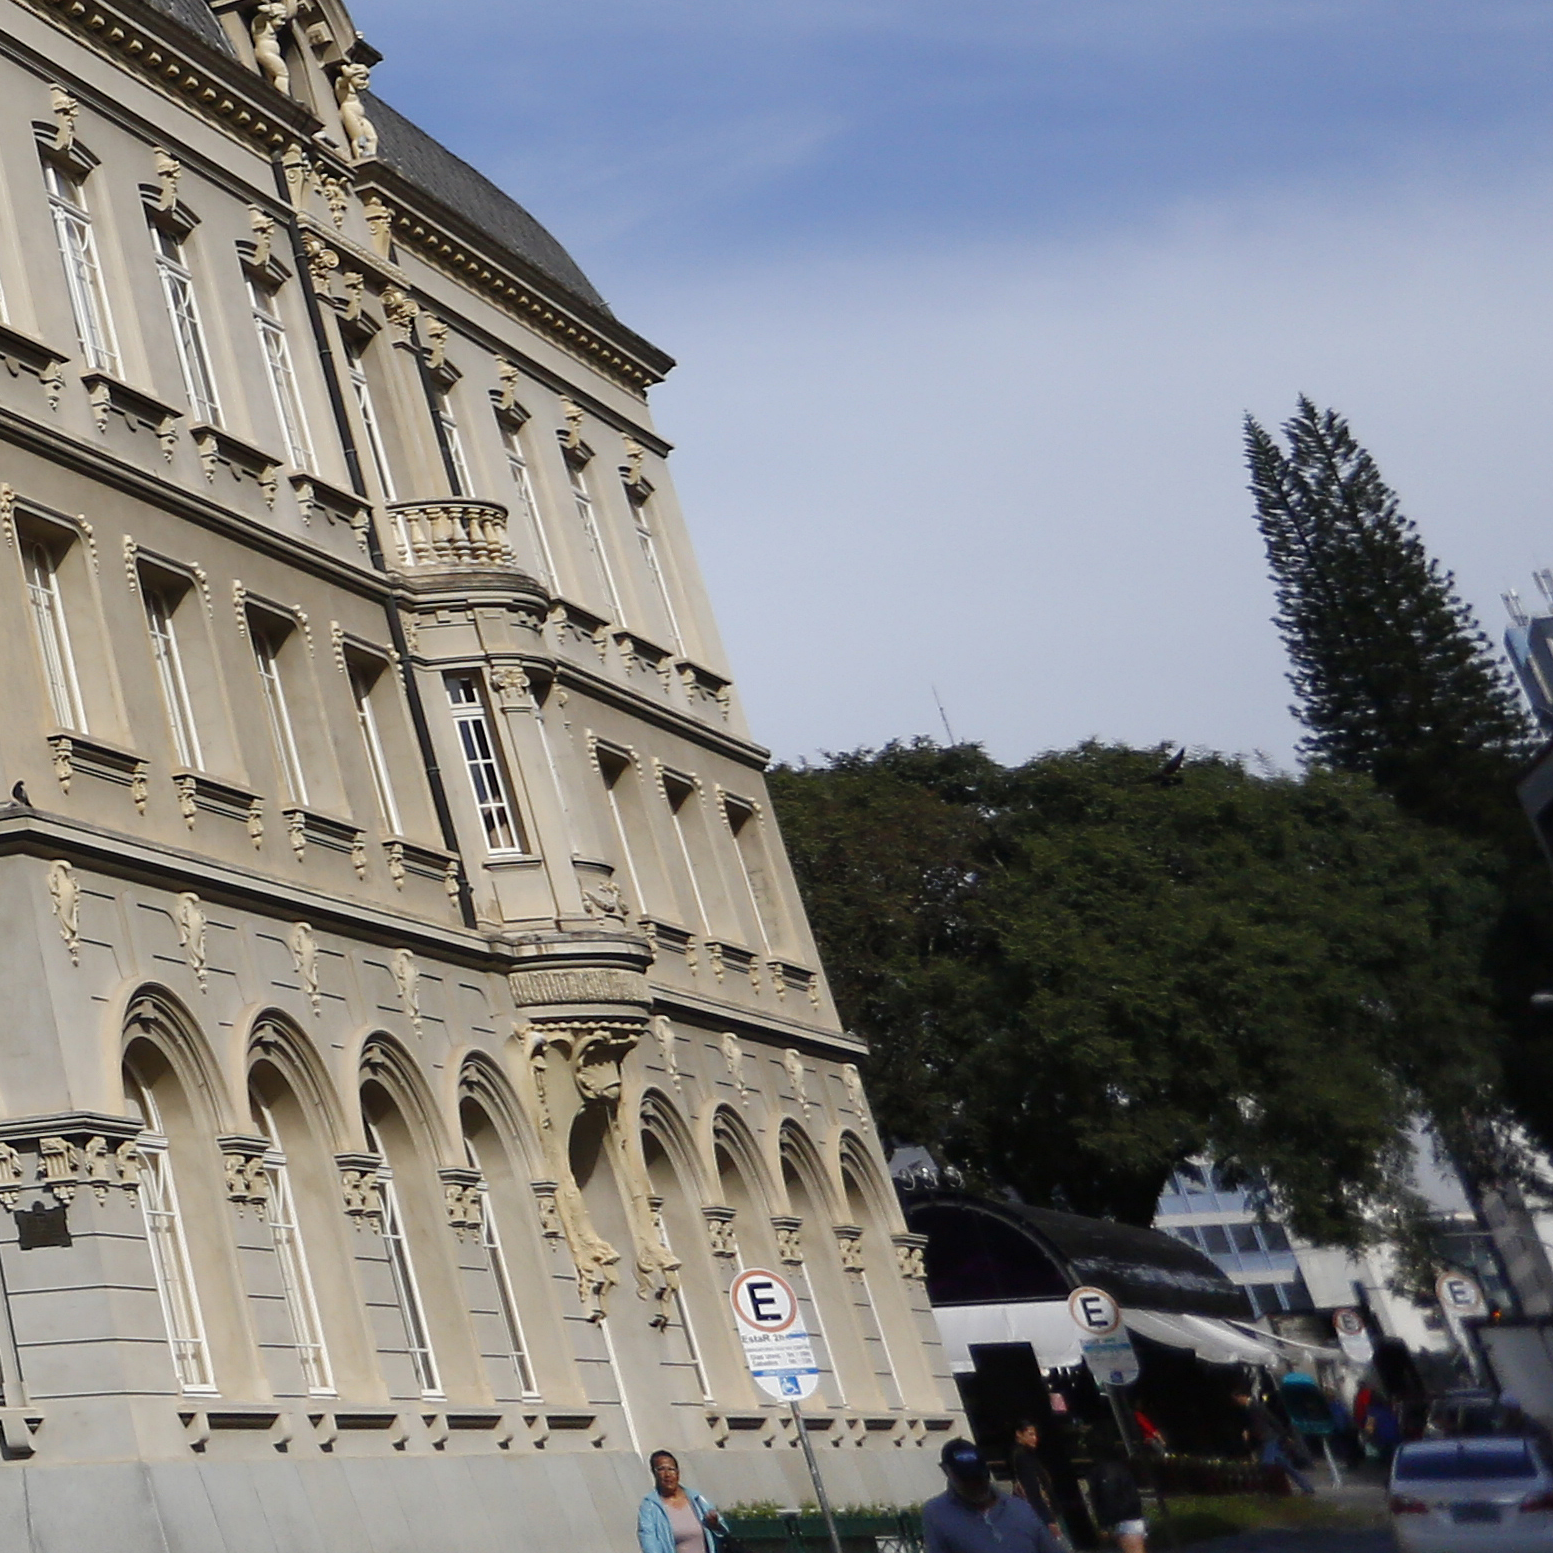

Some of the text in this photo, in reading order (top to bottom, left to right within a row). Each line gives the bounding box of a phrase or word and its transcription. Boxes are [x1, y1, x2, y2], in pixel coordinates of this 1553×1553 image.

[746, 1282, 782, 1321] E
[1449, 1280, 1470, 1304] E
[1079, 1297, 1108, 1326] E
